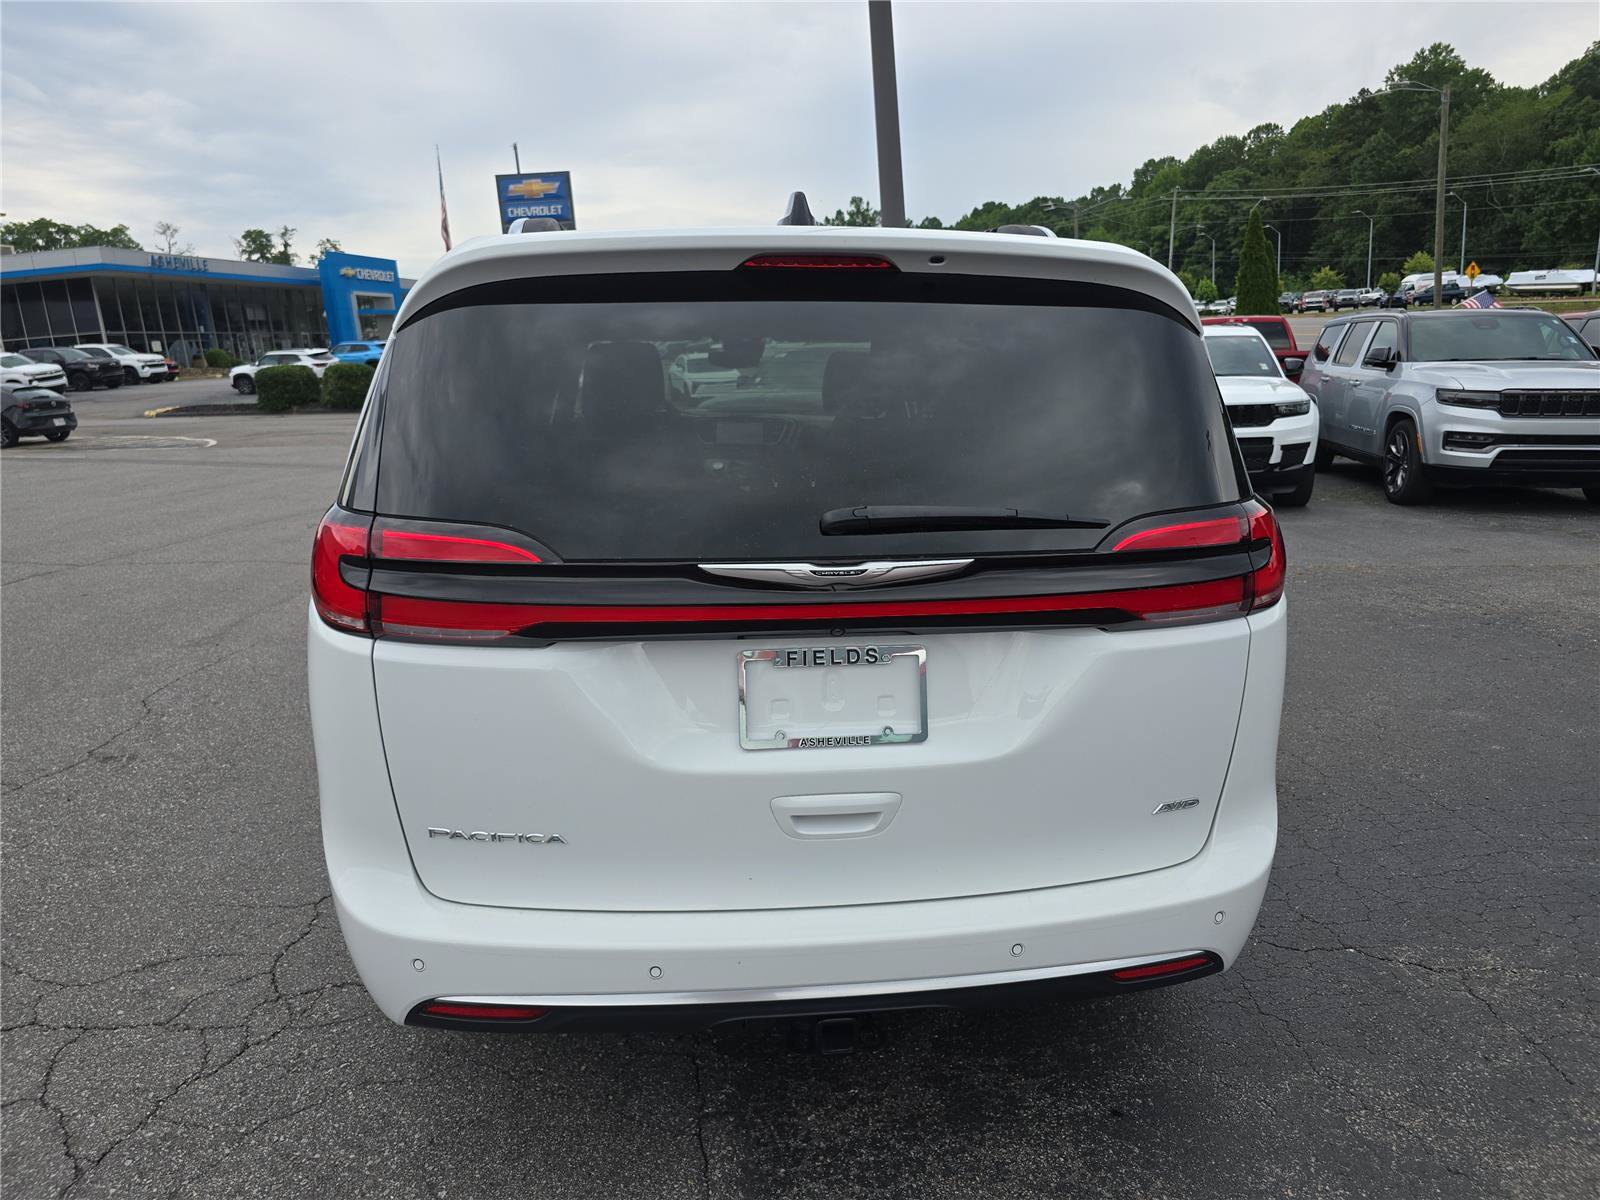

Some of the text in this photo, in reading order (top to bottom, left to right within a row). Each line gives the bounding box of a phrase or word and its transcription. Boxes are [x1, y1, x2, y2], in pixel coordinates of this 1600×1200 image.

[507, 205, 562, 218] CHEVROLET
[150, 255, 209, 272] ASHEVILLE
[357, 268, 395, 282] CHEVROLET
[786, 647, 879, 667] FIELDS
[800, 735, 871, 748] ASHEVILLE
[1152, 799, 1200, 815] AWD
[427, 826, 568, 844] PACIFICA
